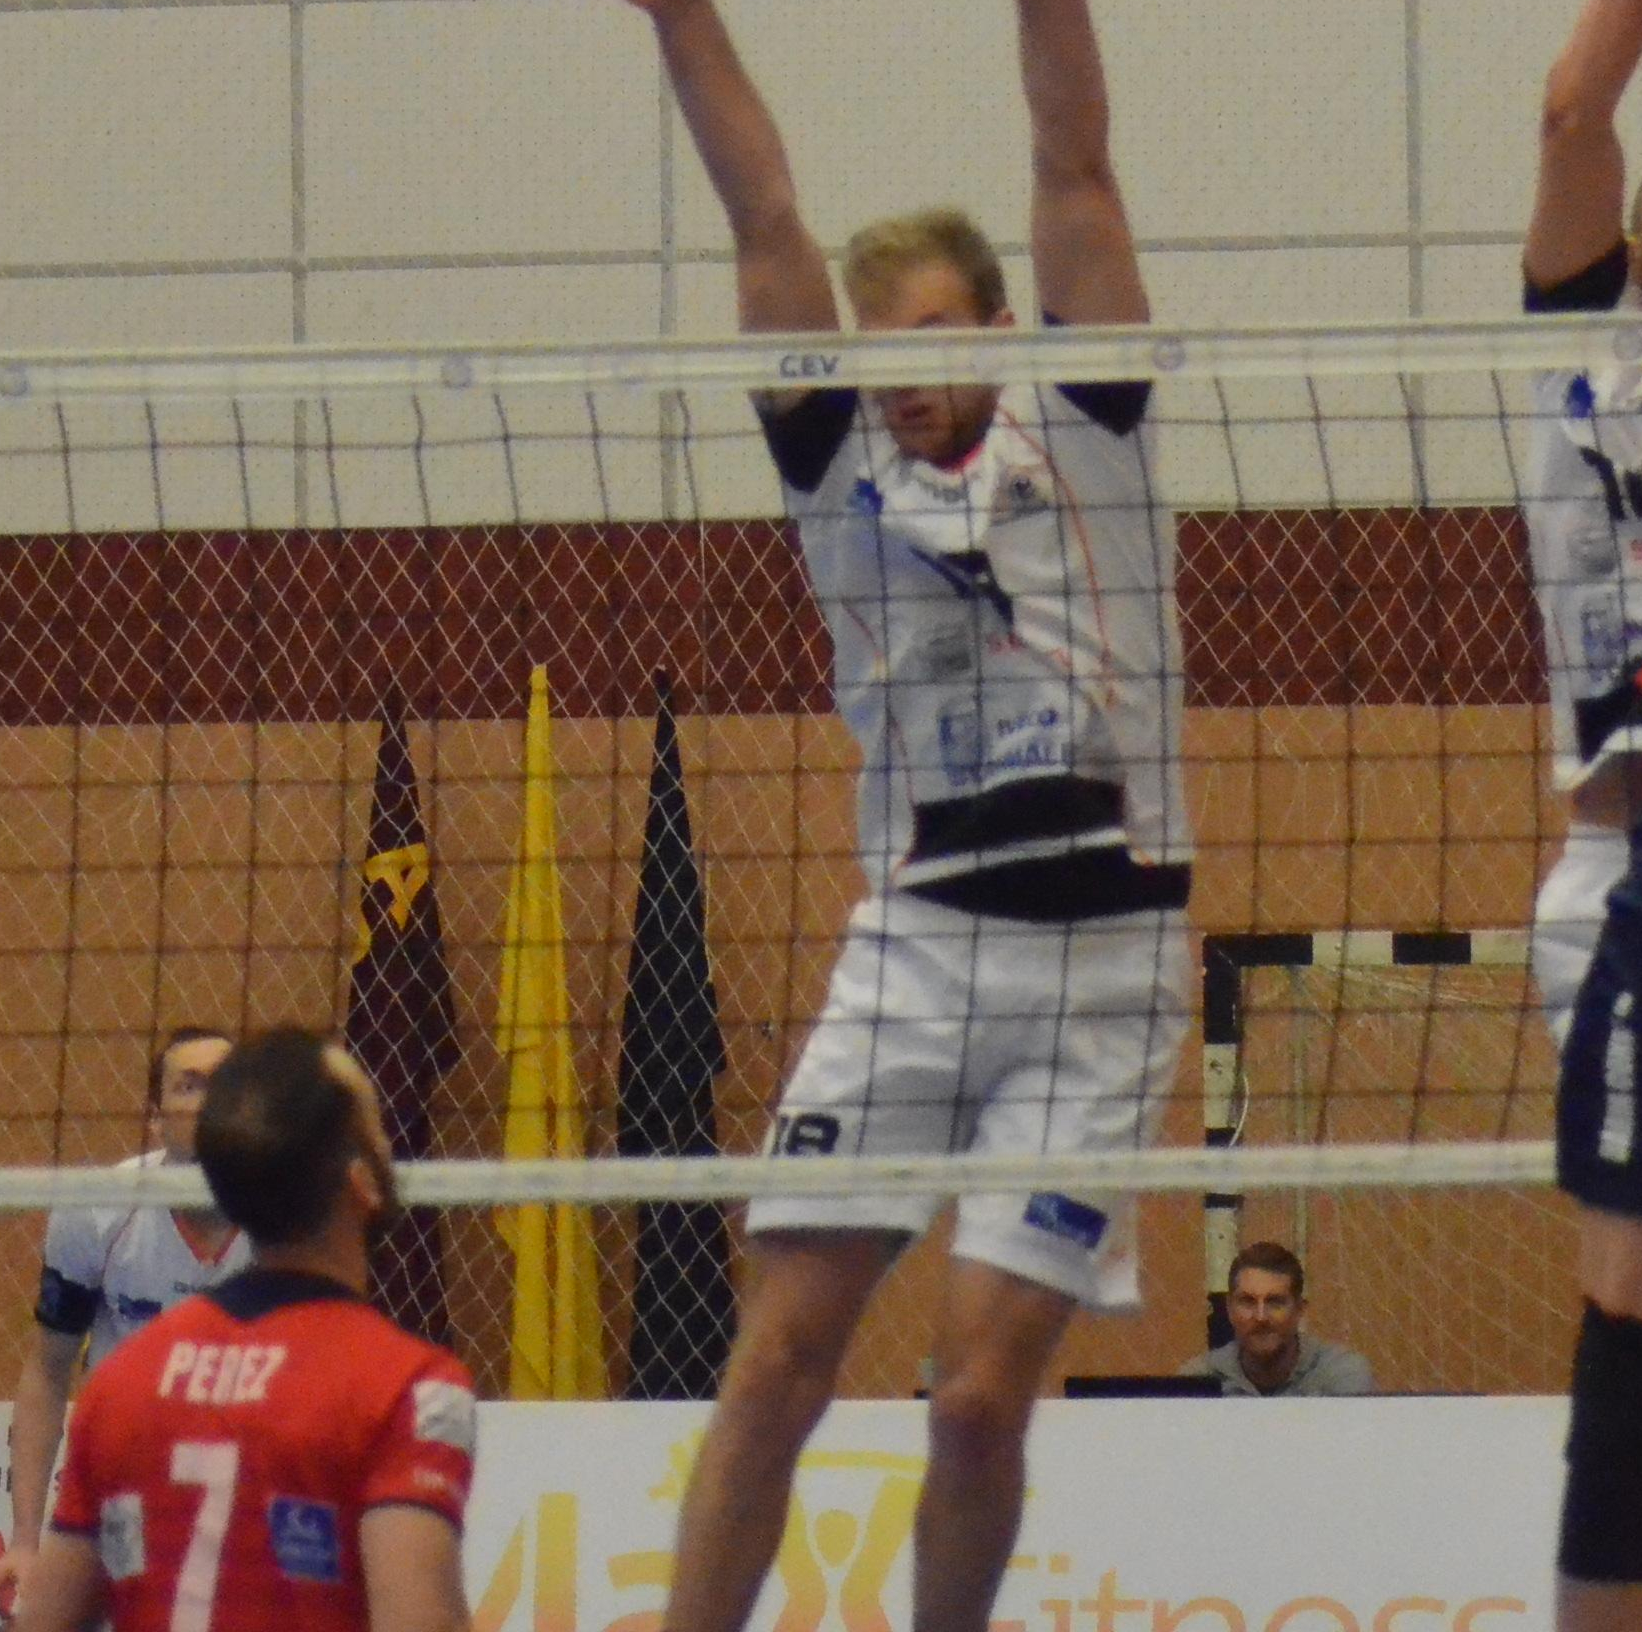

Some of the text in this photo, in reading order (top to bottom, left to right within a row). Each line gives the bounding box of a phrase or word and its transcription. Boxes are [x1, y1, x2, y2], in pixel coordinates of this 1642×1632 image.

[778, 355, 839, 378] CEV
[160, 1341, 288, 1406] PEREZ
[169, 1441, 240, 1632] 7
